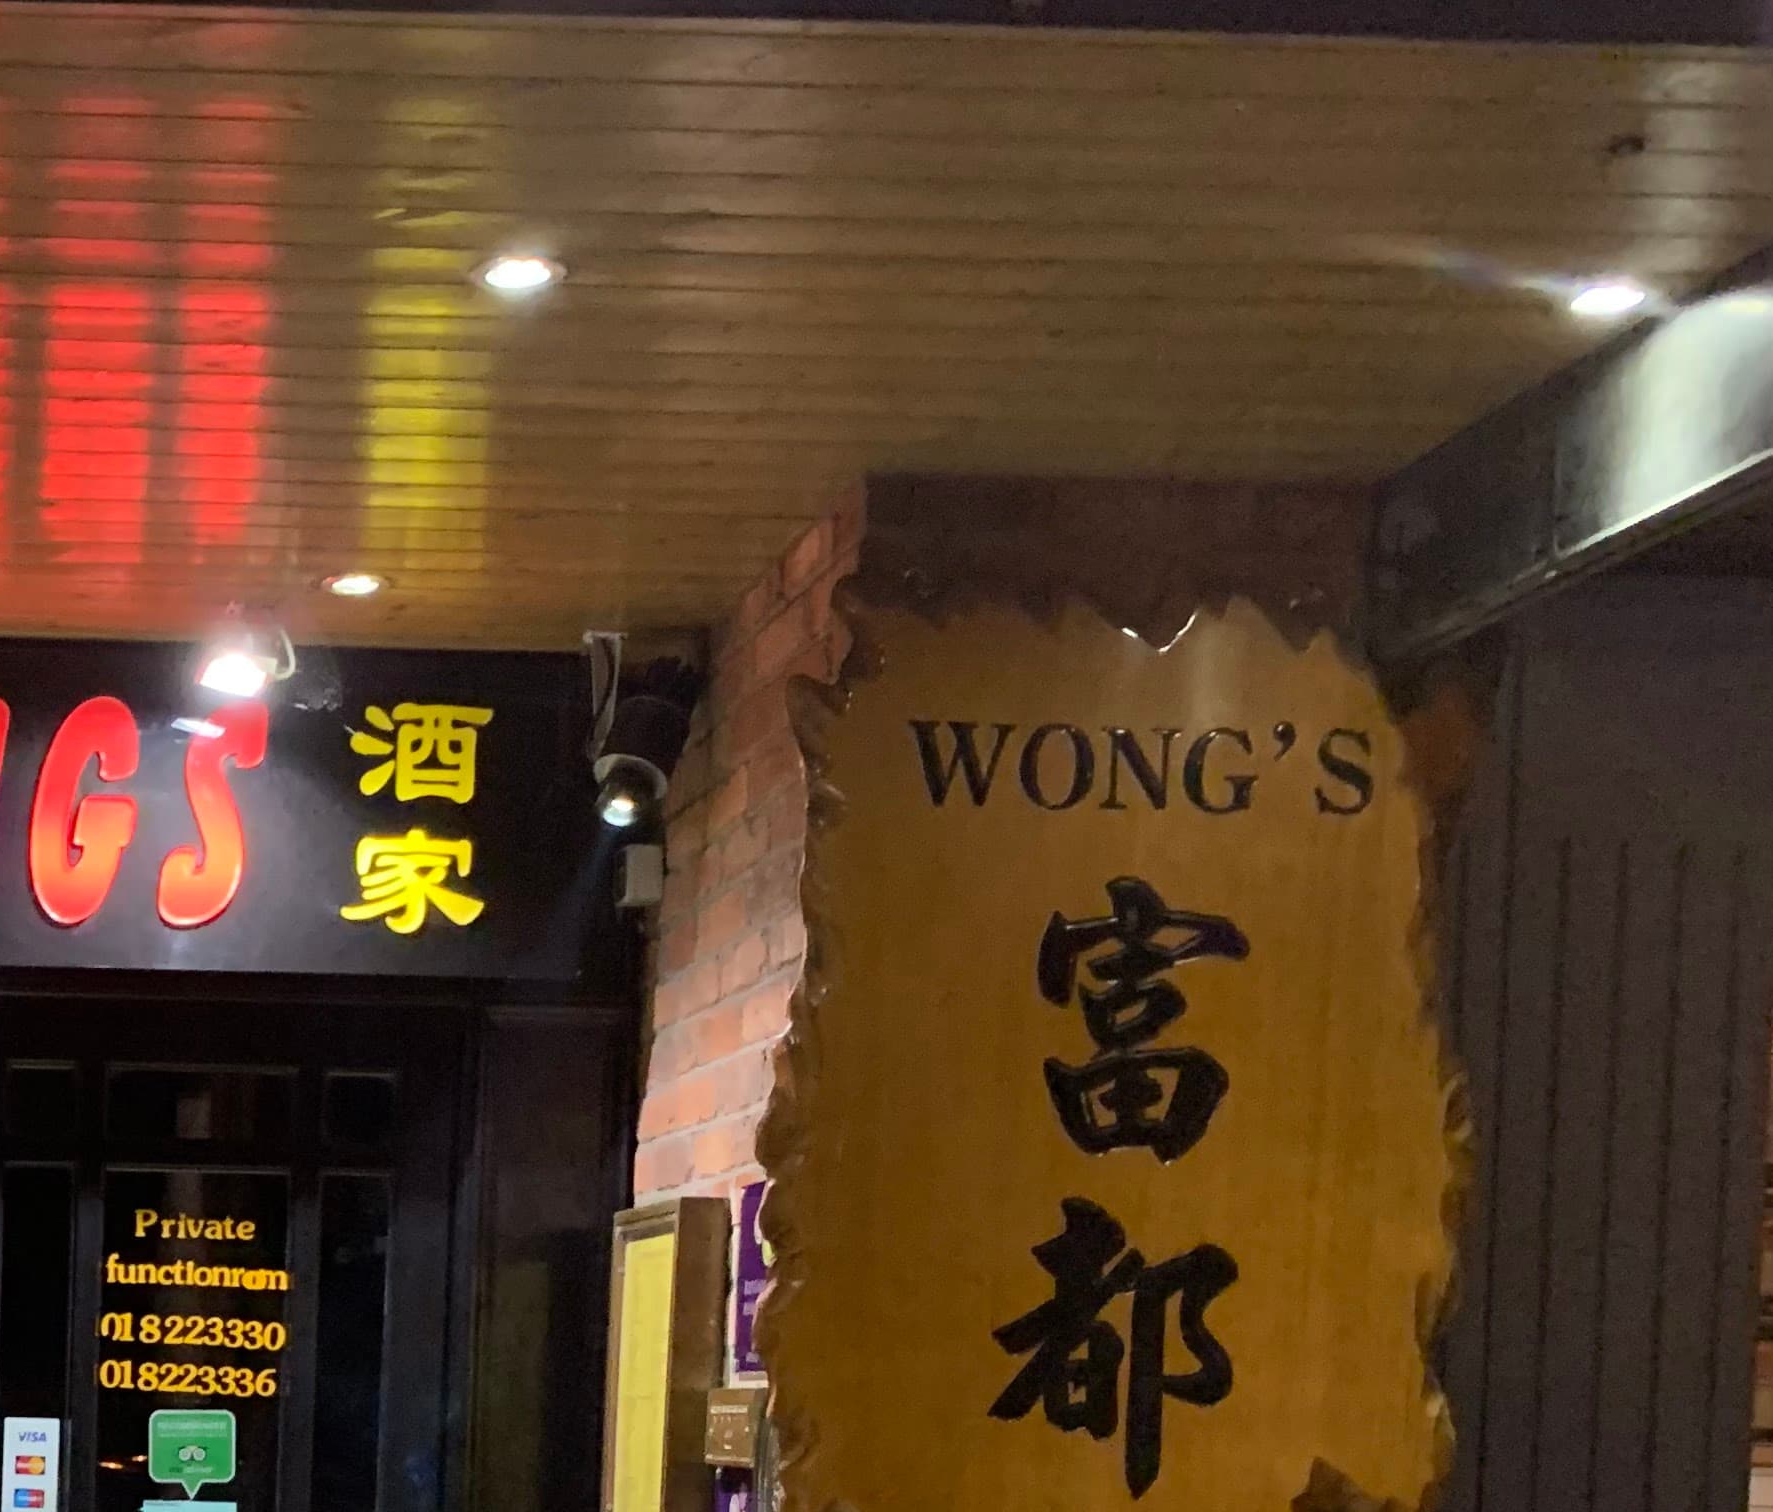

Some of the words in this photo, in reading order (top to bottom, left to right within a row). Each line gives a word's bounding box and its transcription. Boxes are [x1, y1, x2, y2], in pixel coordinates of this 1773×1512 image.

[339, 702, 493, 935] 酒家
[134, 1208, 256, 1241] Private
[986, 875, 1250, 1501] 富都
[18, 1431, 48, 1443] VISA
